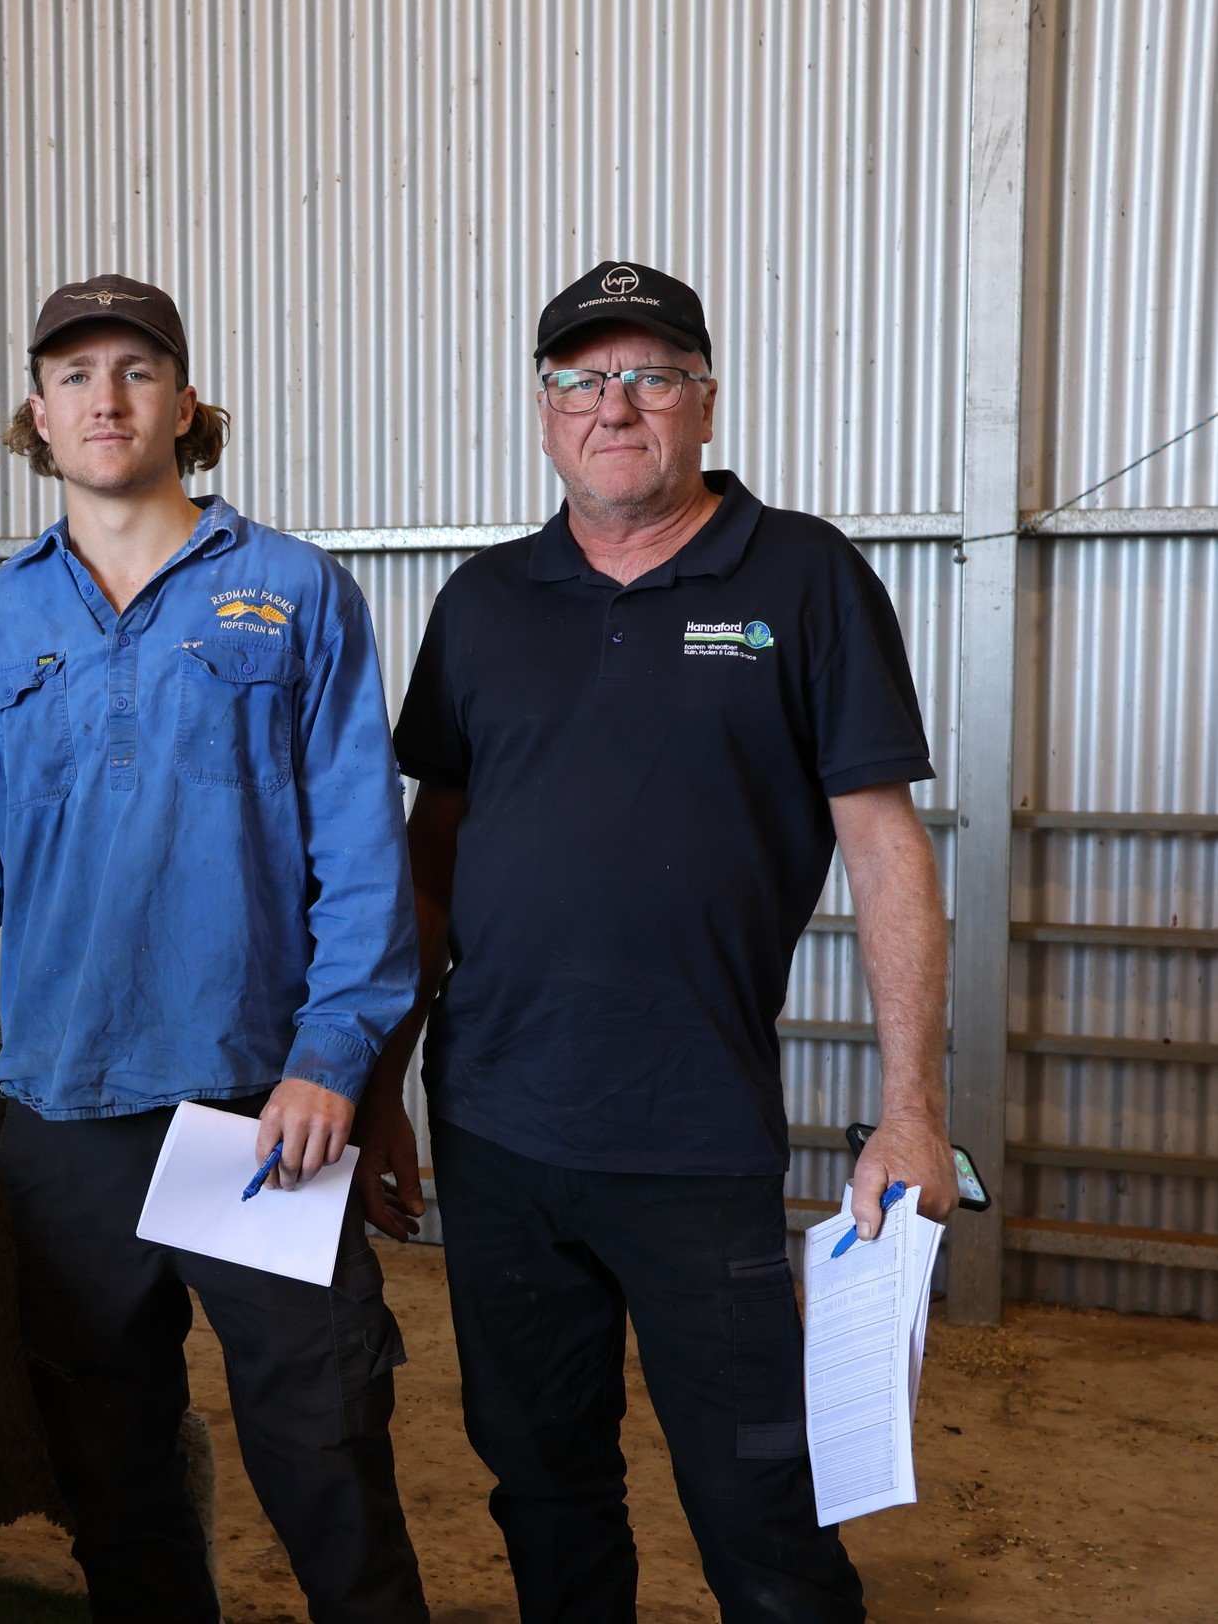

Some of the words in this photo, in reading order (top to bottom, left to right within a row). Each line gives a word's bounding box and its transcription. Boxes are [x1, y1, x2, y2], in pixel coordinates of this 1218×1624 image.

[578, 296, 627, 309] WIRINGA
[630, 296, 661, 307] PARK
[210, 588, 257, 606] REDMAN
[260, 590, 296, 614] FARMS
[220, 620, 267, 634] HOPETOUN
[268, 627, 281, 636] WA
[686, 621, 742, 633] Hannaford
